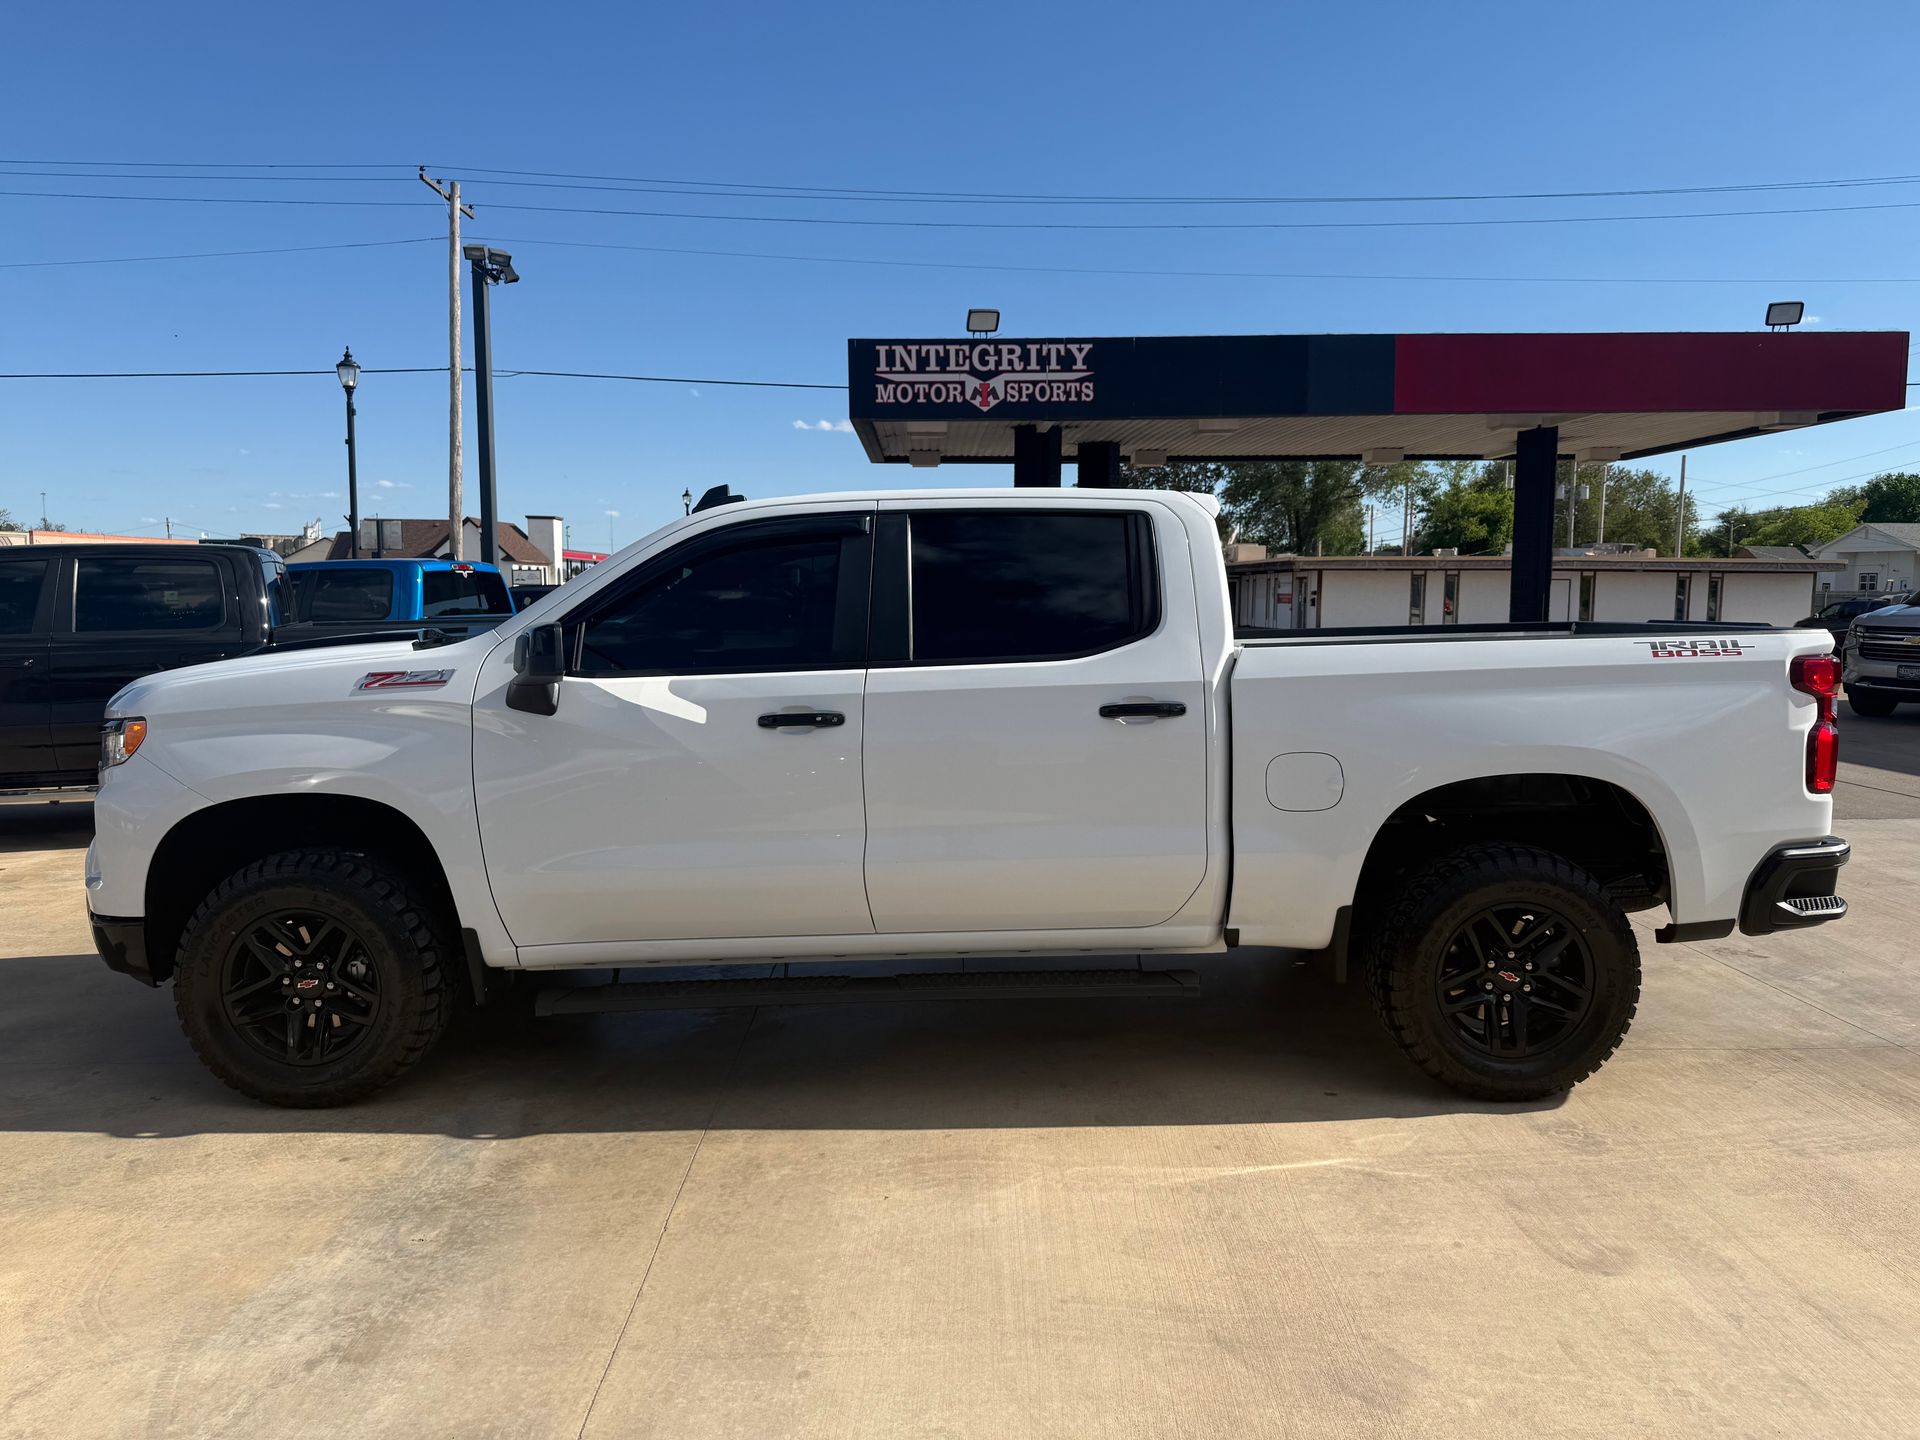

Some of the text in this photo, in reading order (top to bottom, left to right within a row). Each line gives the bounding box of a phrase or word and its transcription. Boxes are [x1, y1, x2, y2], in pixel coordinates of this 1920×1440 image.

[875, 343, 1093, 372] INTEGRITY
[875, 381, 1095, 404] MOTOR SPORTS
[1633, 639, 1756, 651] TRAIL
[1651, 648, 1743, 658] BOSS
[358, 668, 457, 691] Z71
